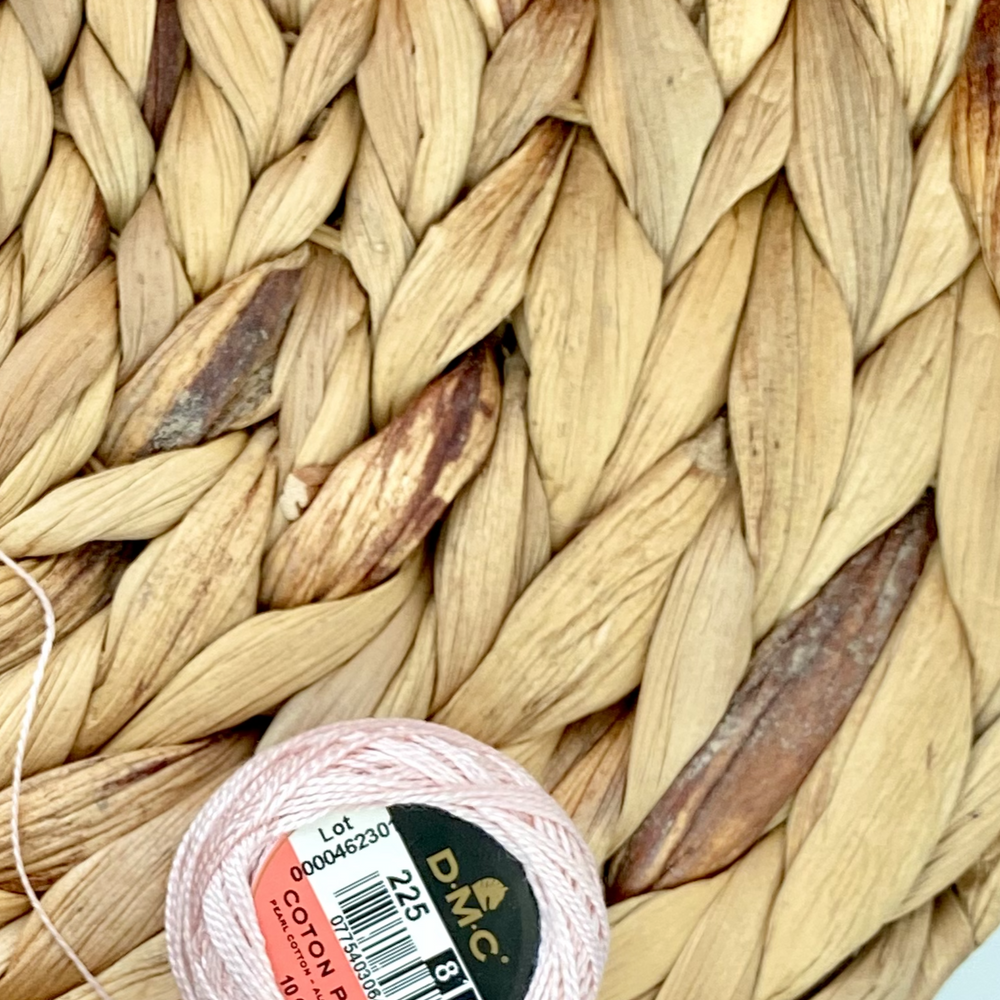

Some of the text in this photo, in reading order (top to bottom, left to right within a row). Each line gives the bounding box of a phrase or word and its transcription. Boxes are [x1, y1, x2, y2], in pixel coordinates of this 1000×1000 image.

[290, 818, 394, 882] 000046230
[318, 815, 354, 843] Lot
[269, 899, 288, 933] PEARL
[287, 934, 312, 977] COTTON
[283, 889, 335, 978] COTON
[386, 869, 430, 921] 225
[434, 960, 460, 982] 8
[280, 974, 299, 996] 10
